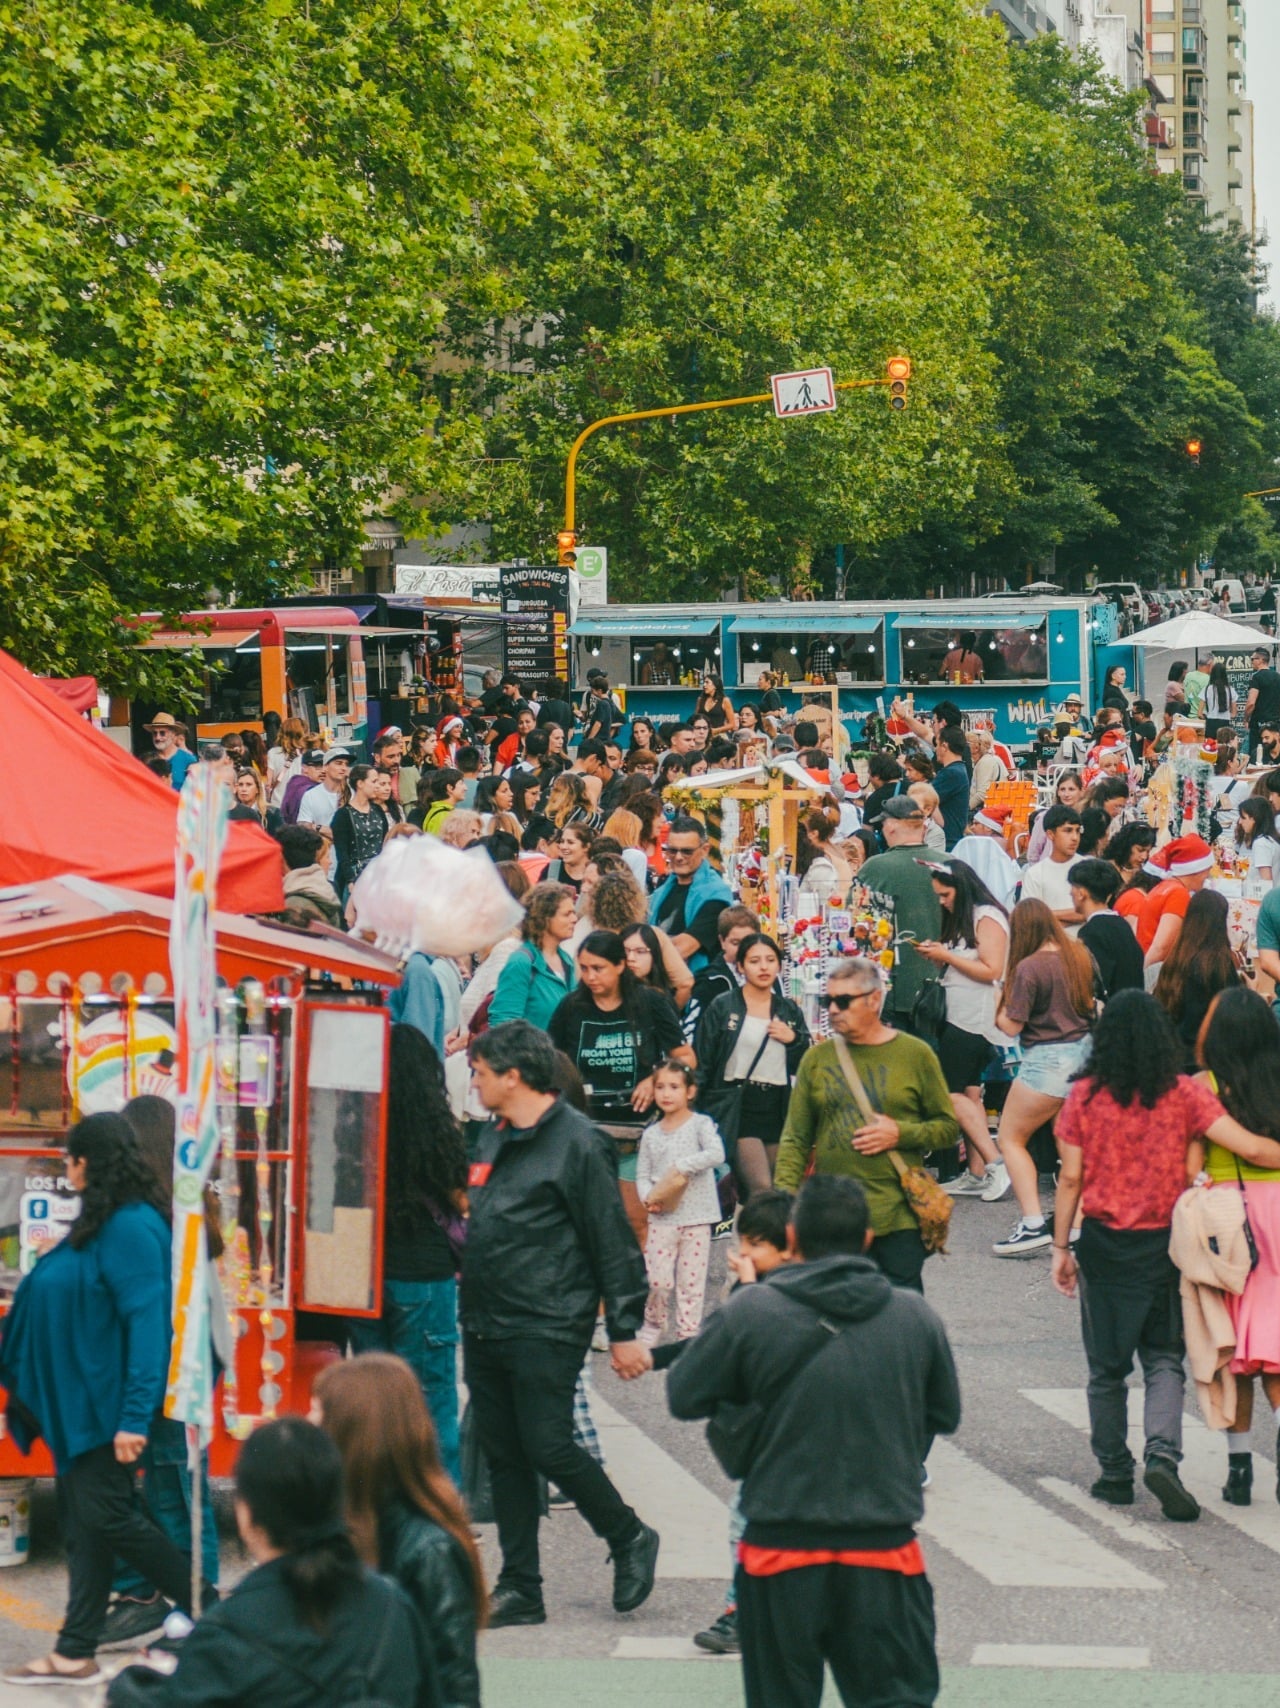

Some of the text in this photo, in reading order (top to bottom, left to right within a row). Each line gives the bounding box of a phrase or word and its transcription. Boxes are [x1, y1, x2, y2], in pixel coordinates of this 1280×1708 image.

[501, 569, 568, 586] SANDWICHES
[580, 1047, 633, 1058] FROM YOUR
[587, 1056, 633, 1066] COMFORT
[611, 1065, 634, 1073] ZONE
[25, 1176, 53, 1190] LOS
